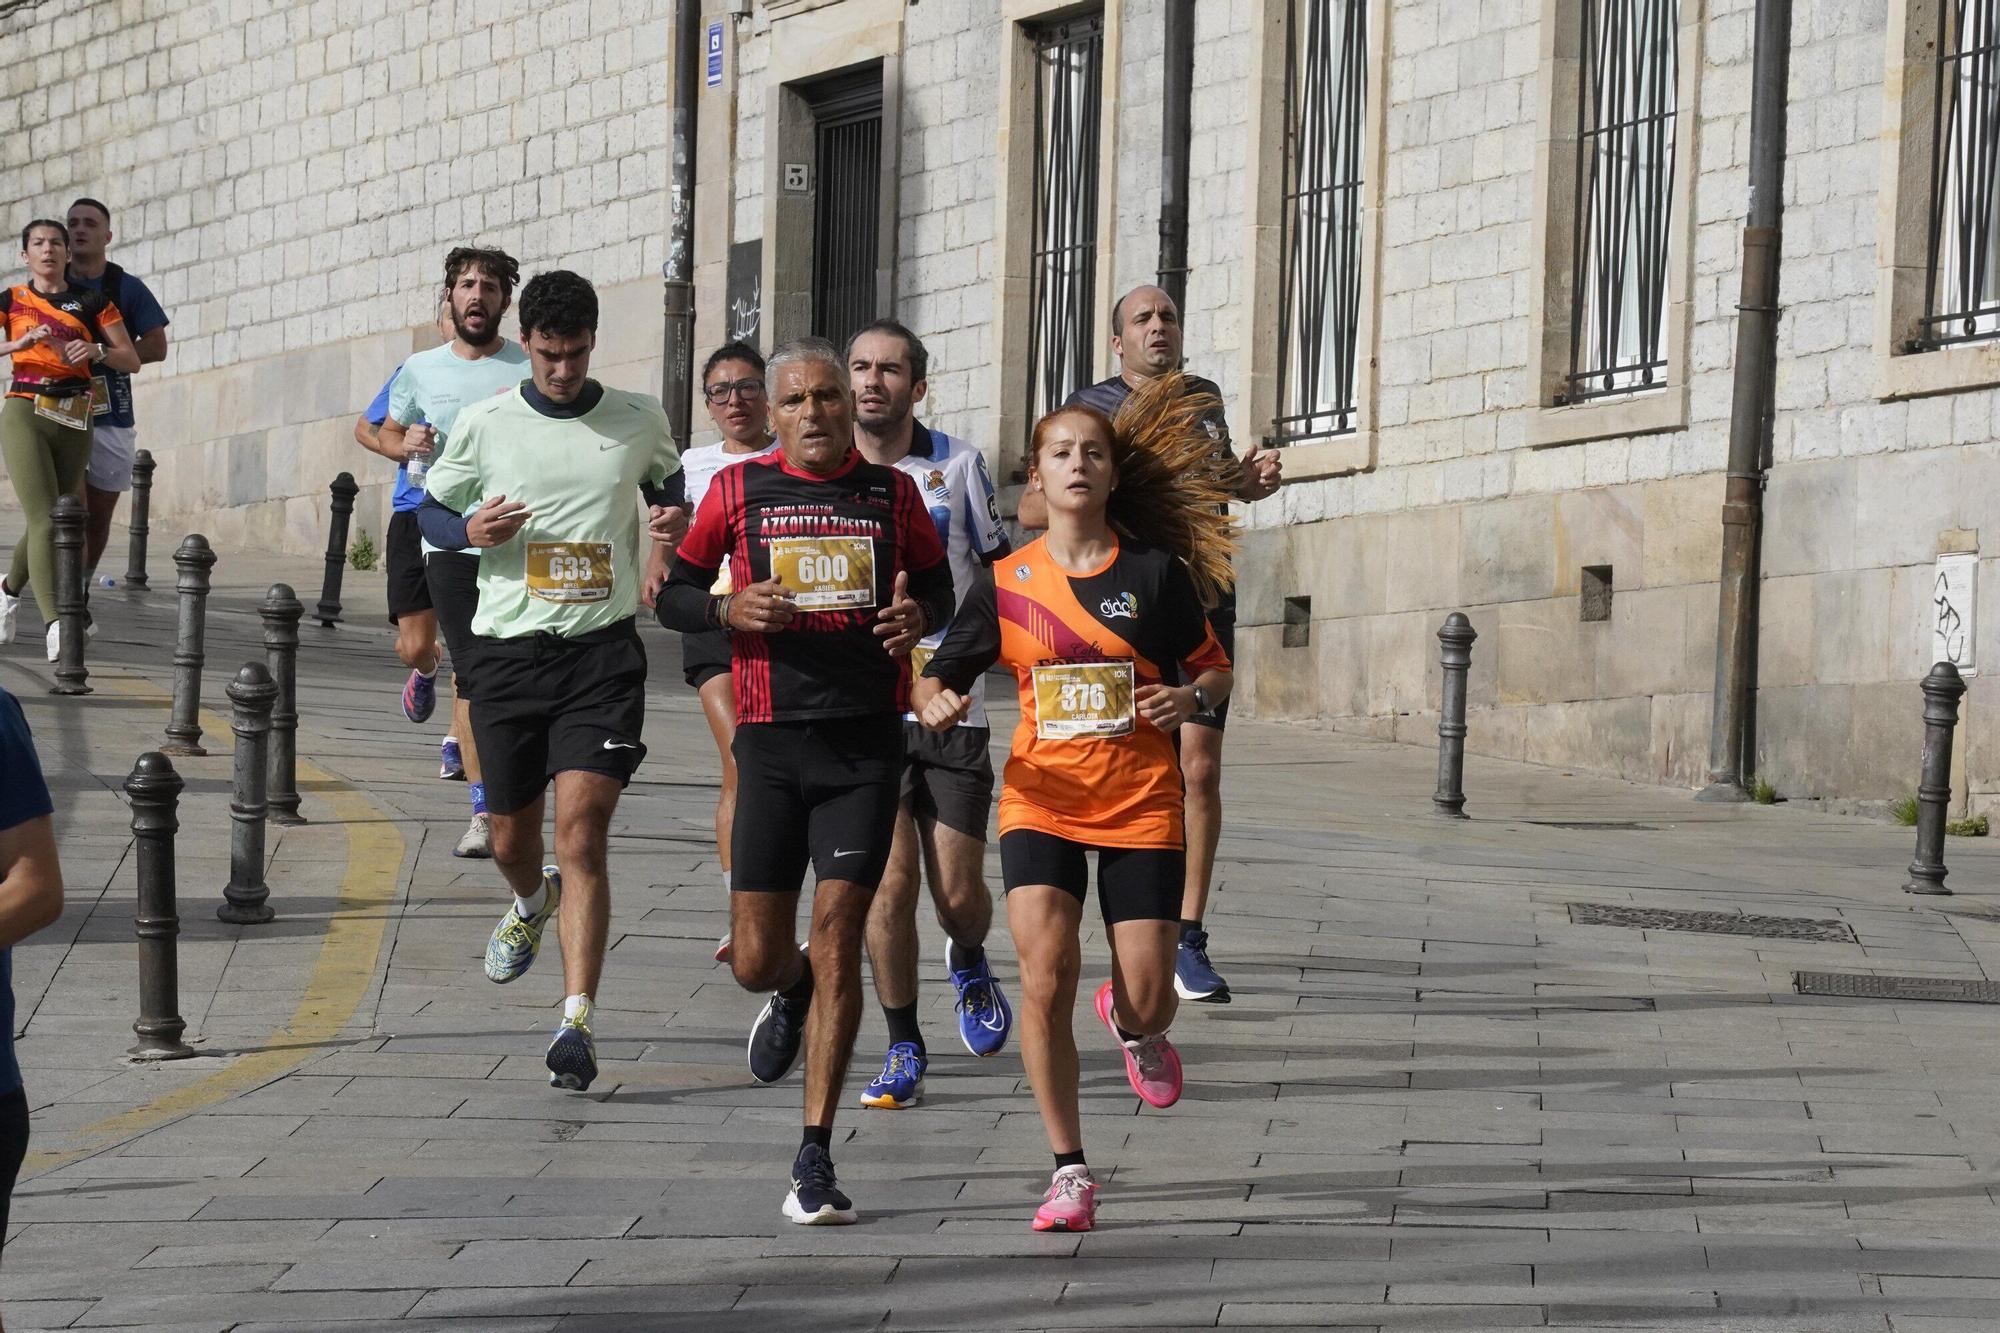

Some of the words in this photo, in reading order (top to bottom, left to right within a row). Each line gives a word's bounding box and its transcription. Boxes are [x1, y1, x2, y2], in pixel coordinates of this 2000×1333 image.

[790, 168, 803, 186] 5
[760, 516, 883, 538] AZKOITIAZPEITIA
[549, 556, 593, 581] 633
[798, 555, 849, 584] 600
[1114, 670, 1128, 678] 10K
[1060, 683, 1107, 712] 376
